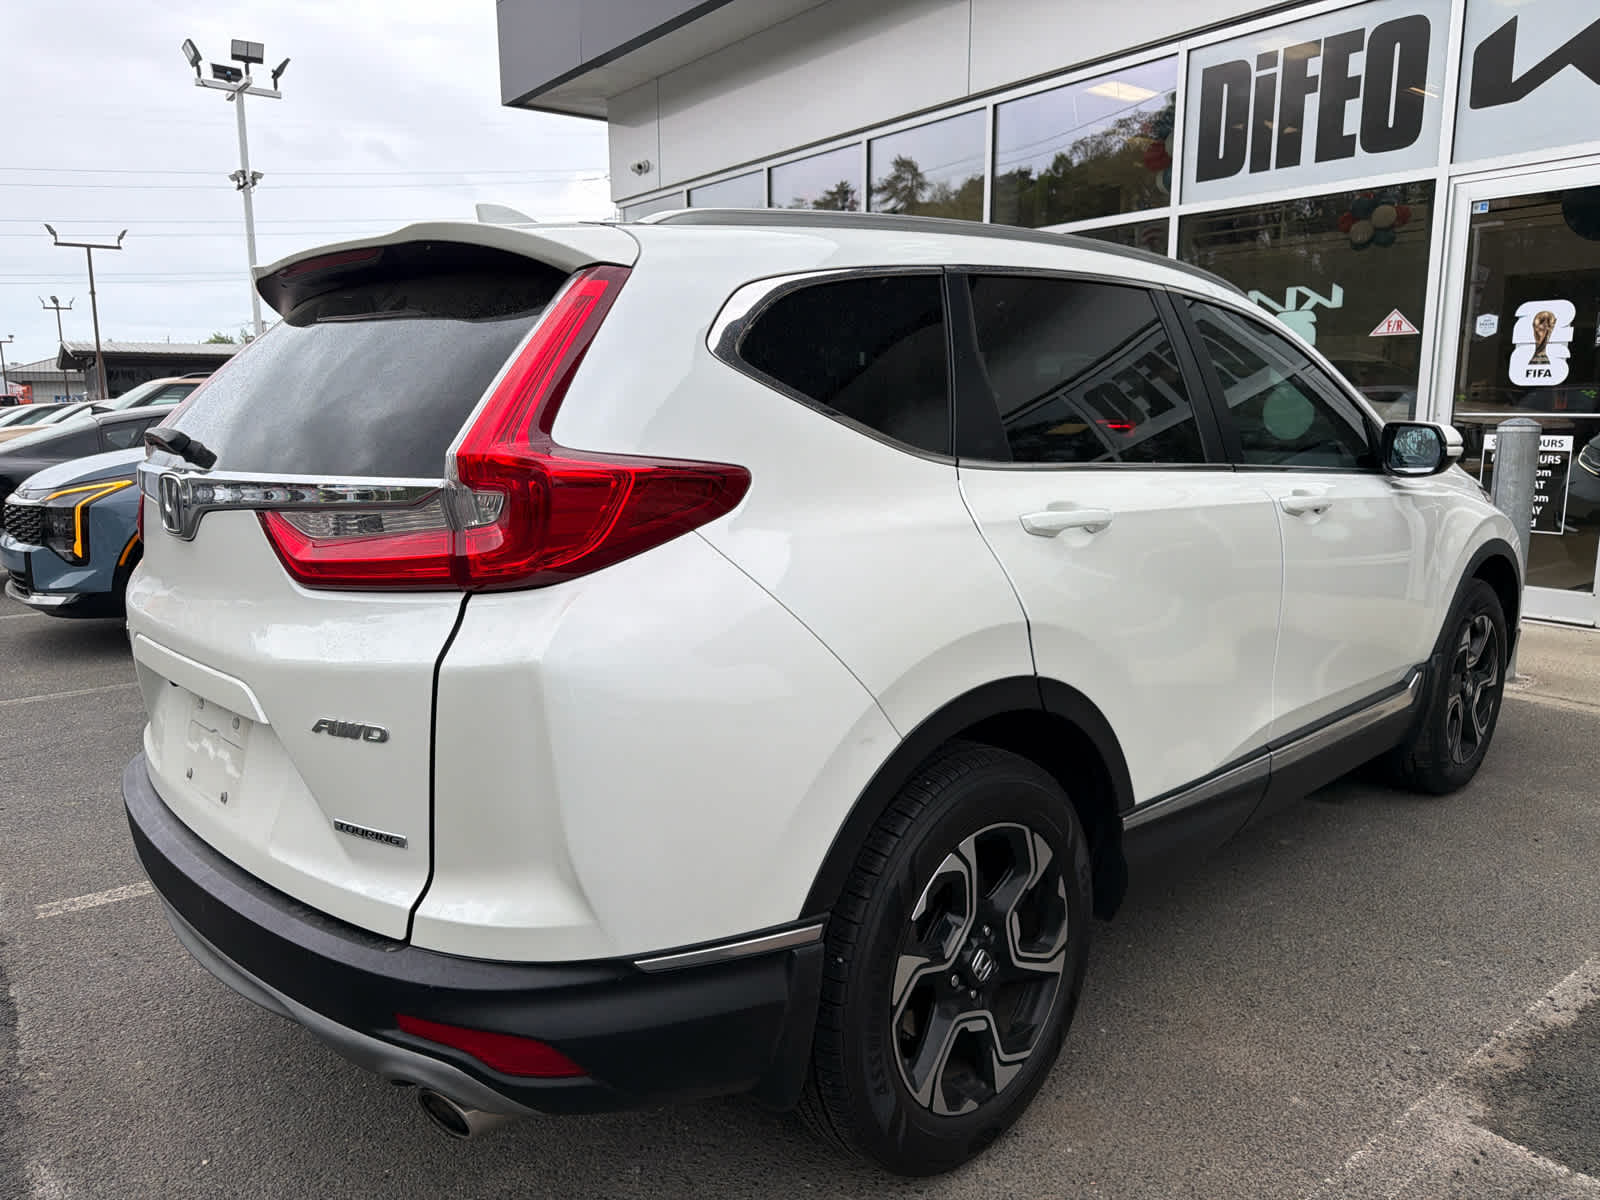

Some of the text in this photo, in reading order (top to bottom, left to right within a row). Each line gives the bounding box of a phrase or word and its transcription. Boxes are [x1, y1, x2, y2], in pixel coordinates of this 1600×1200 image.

[1387, 319, 1402, 332] F/R
[1525, 368, 1552, 378] FIFA
[311, 717, 389, 744] AWD
[336, 820, 404, 847] TOURING
